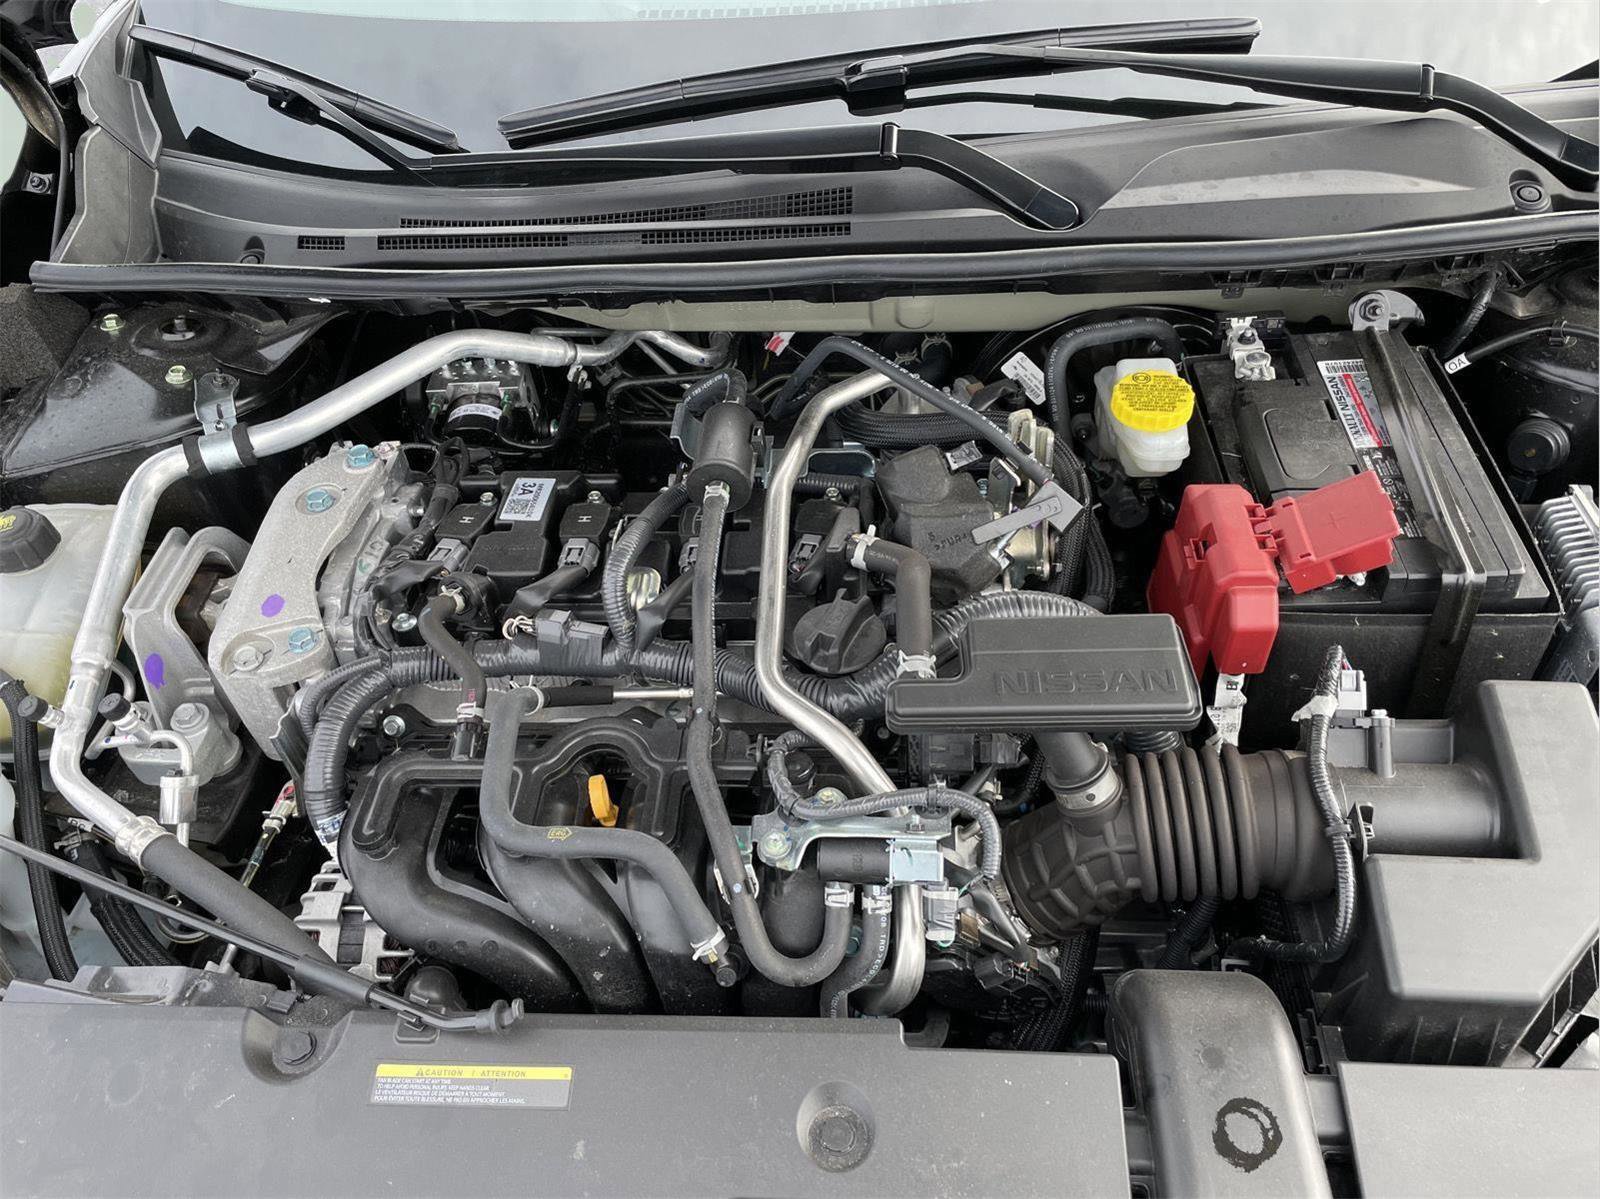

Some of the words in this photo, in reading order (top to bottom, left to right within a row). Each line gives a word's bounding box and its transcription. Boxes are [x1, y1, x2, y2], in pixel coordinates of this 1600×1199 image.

[1326, 376, 1350, 411] NISSAN
[993, 670, 1178, 695] NISSAN
[424, 1069, 464, 1077] CAUTION
[480, 1070, 527, 1078] ATTENTION
